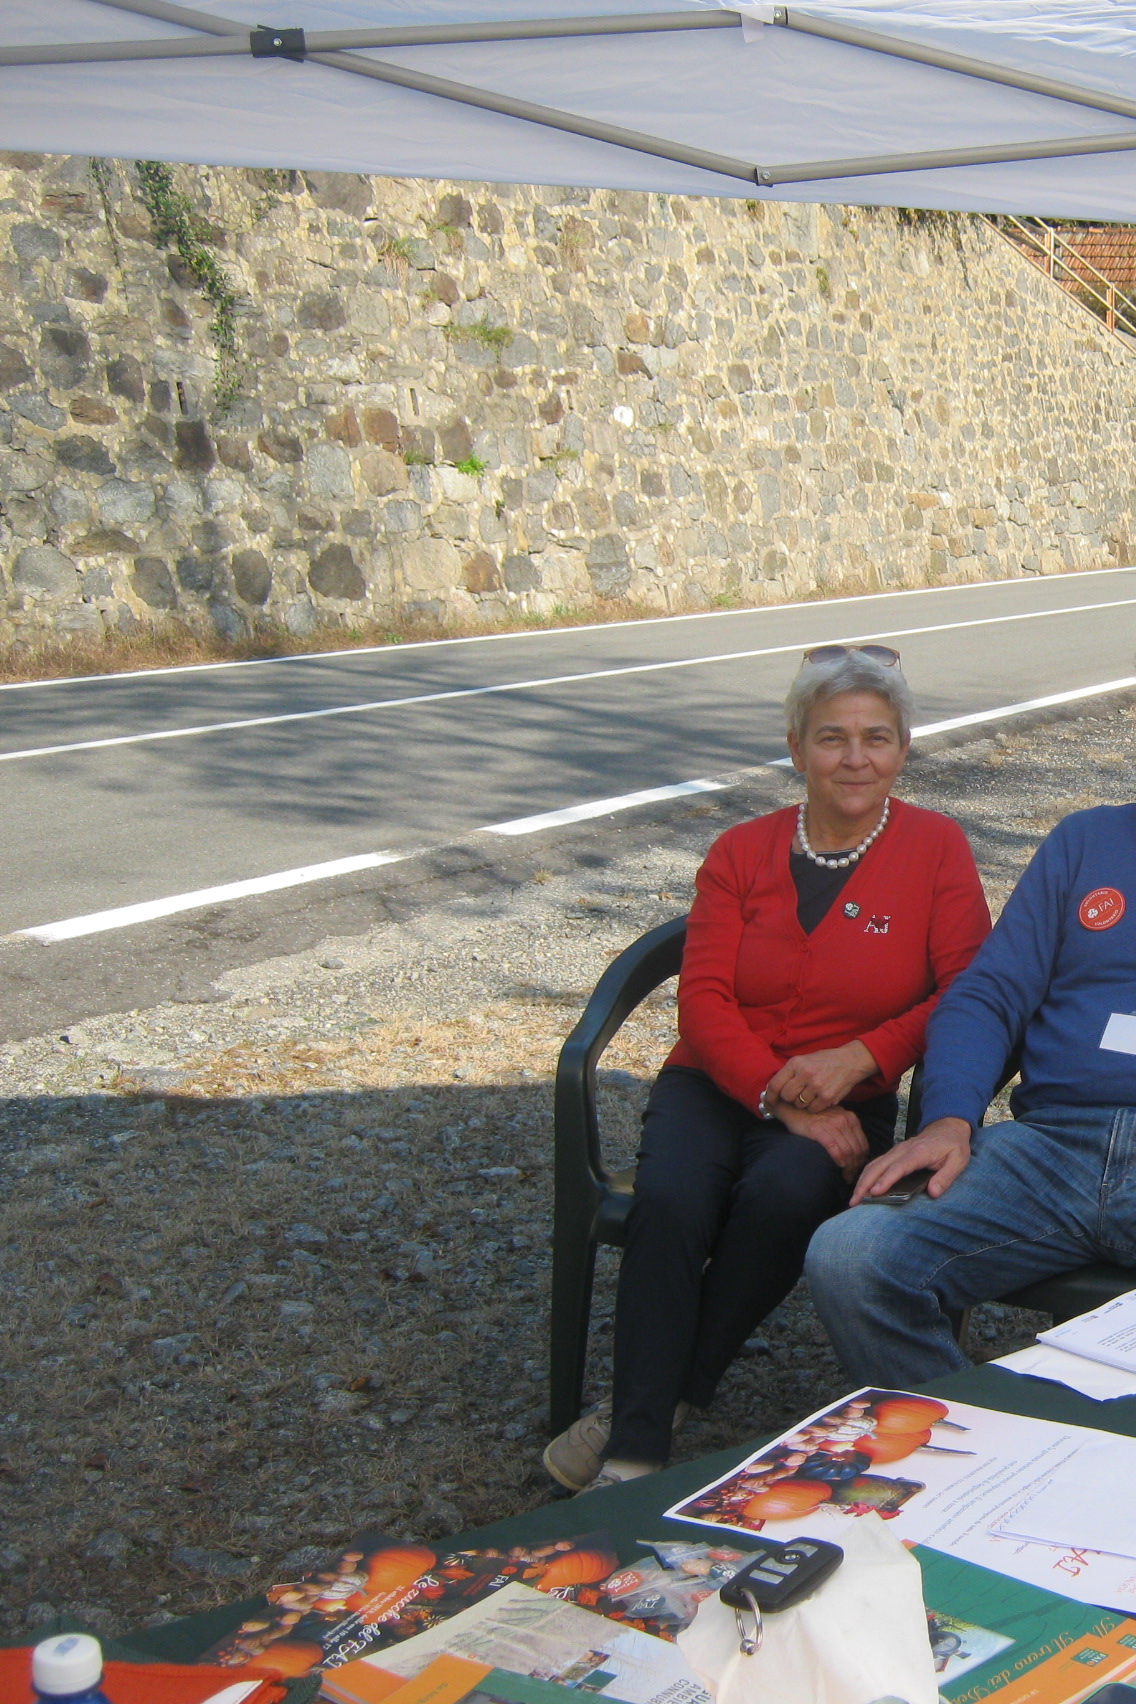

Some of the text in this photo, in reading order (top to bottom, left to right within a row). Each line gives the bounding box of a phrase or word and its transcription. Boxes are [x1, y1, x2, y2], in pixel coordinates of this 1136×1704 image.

[1098, 898, 1114, 912] FAI
[414, 1574, 439, 1589] Le
[488, 1574, 510, 1587] FAI
[378, 1589, 420, 1620] zucche
[358, 1622, 380, 1642] del
[322, 1640, 366, 1668] FAI
[1014, 1644, 1052, 1670] treno
[987, 1668, 1011, 1690] dei
[667, 1684, 701, 1704] AMBIE
